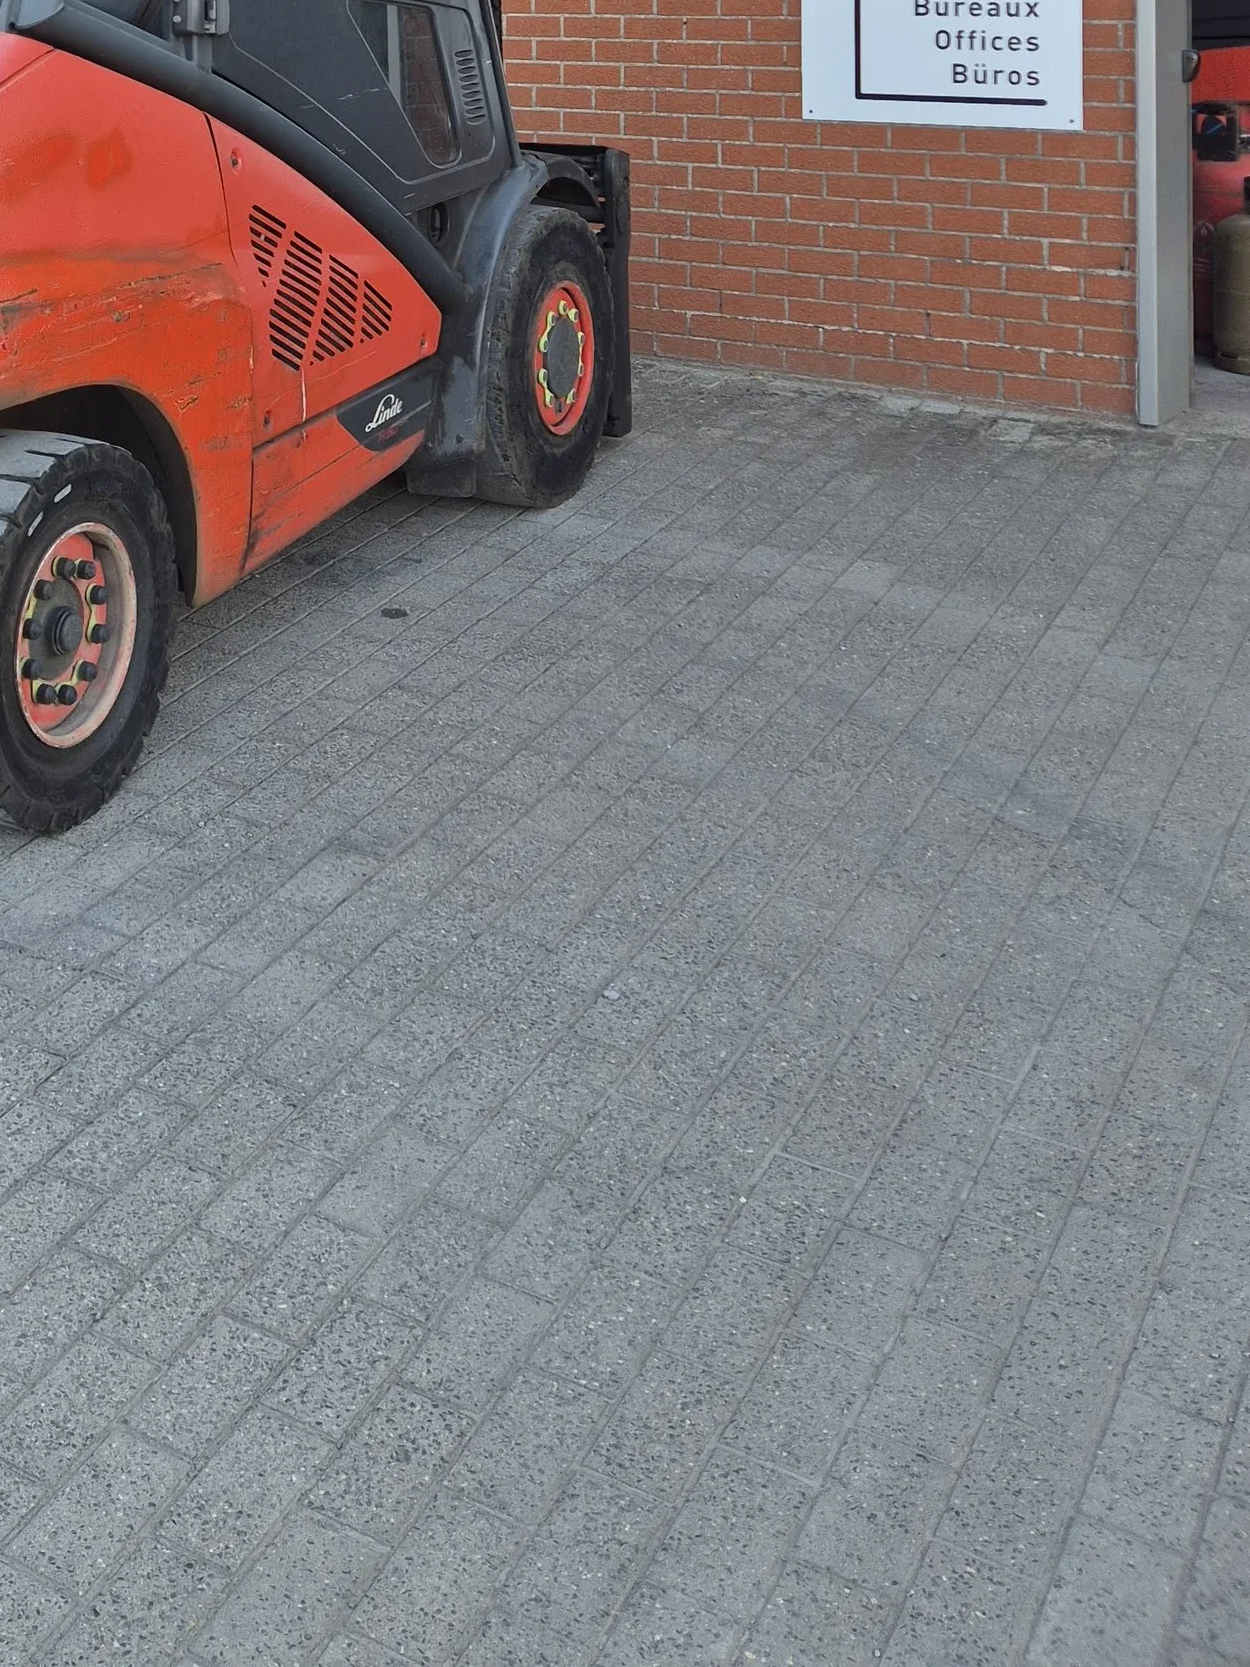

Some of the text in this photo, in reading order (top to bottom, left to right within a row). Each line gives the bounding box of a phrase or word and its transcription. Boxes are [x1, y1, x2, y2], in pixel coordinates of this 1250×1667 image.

[935, 29, 1040, 52] Offices
[952, 63, 1041, 86] Büros
[365, 394, 403, 432] Linde
